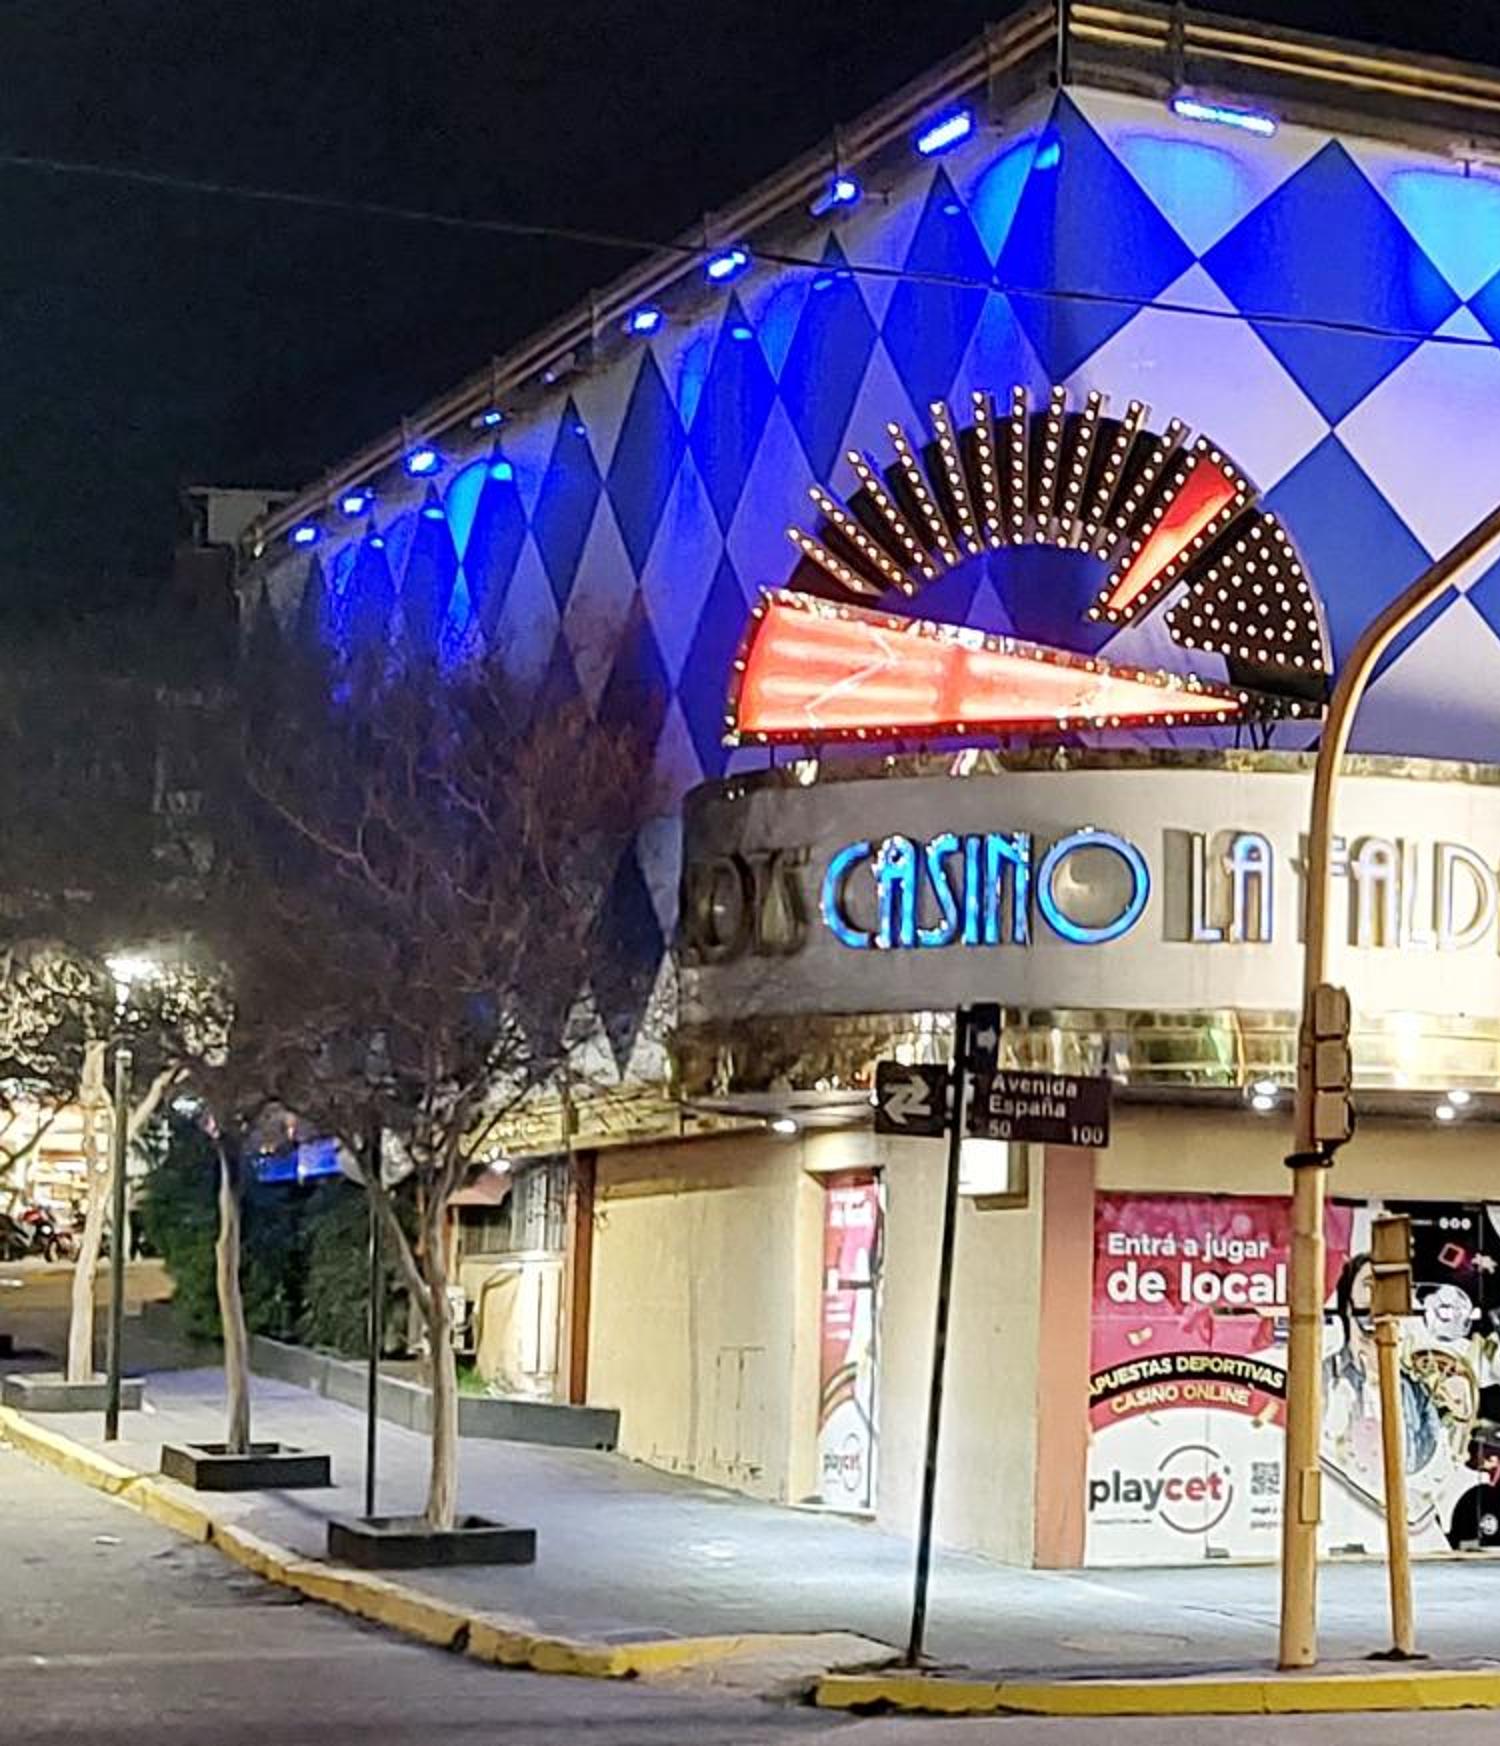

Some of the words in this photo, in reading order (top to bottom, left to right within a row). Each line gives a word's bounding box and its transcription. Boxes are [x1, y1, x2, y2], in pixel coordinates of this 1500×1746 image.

[821, 826, 1151, 950] CASINO
[1180, 830, 1273, 943] LA
[992, 1074, 1078, 1098] Avenida
[989, 1094, 1067, 1119] España
[989, 1119, 1012, 1137] 50
[1071, 1125, 1104, 1145] 100
[1107, 1231, 1176, 1256] Entrá
[1183, 1238, 1199, 1256] a
[1201, 1231, 1270, 1264] jugar
[1107, 1261, 1167, 1304] de
[1181, 1261, 1287, 1304] local
[1176, 1355, 1285, 1389] DEPORTIVAS
[1111, 1384, 1178, 1414] CASINO
[1182, 1383, 1251, 1407] ONLINE
[1088, 1469, 1224, 1512] playcet
